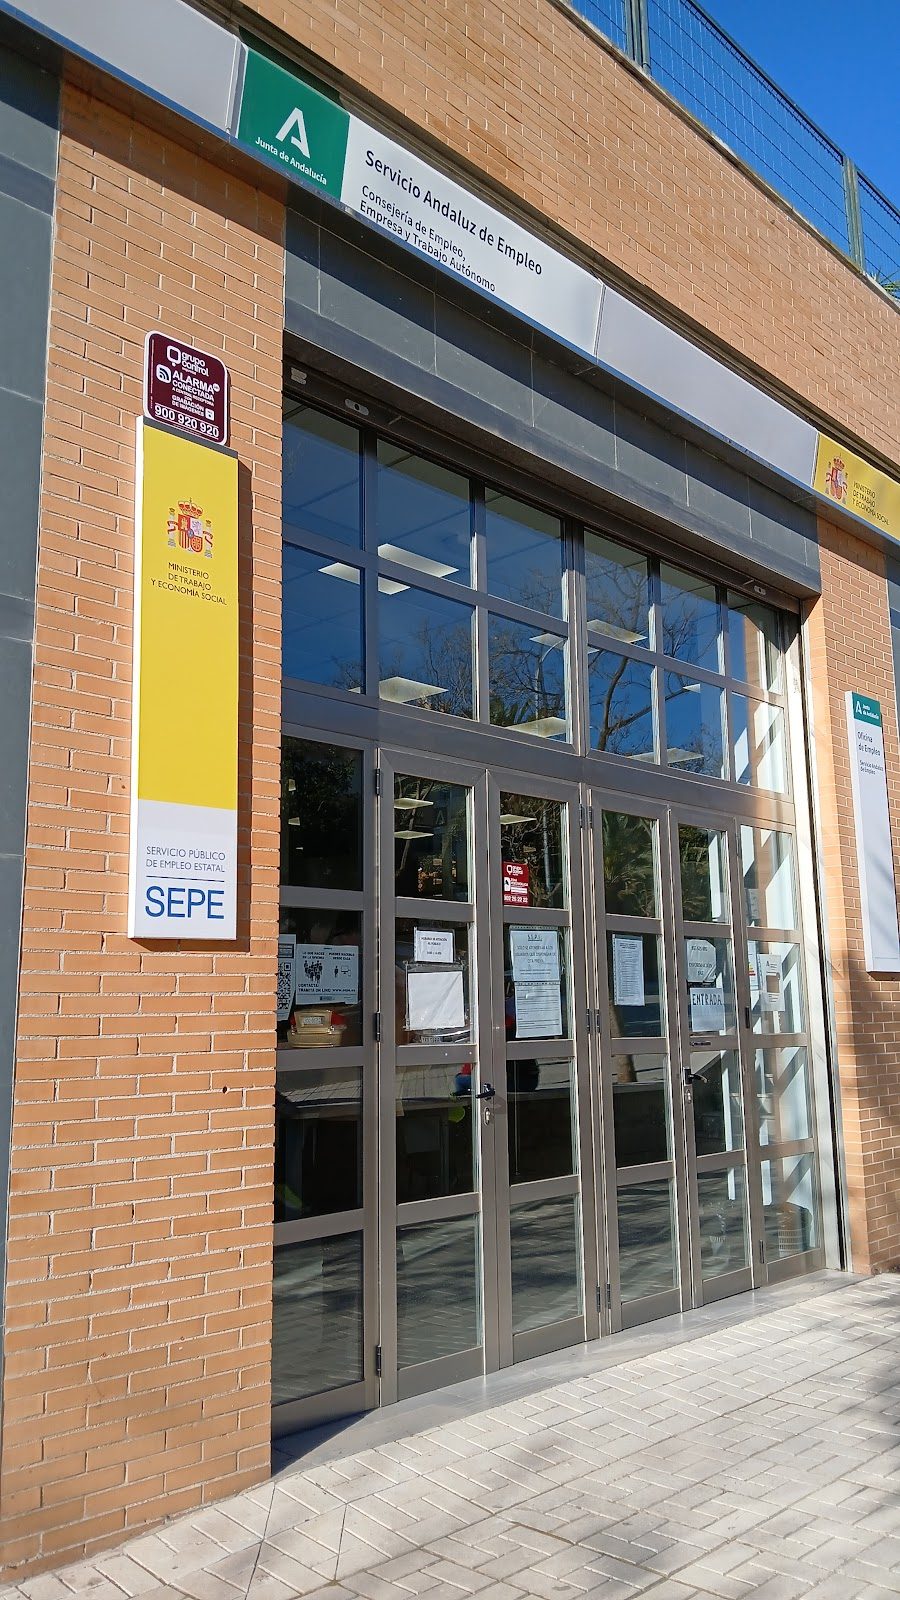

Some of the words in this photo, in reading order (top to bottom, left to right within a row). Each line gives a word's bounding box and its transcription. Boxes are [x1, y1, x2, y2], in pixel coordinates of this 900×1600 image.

[255, 136, 278, 157] Junta
[278, 150, 289, 163] de
[289, 156, 327, 186] Andalucía
[365, 150, 421, 199] Servicio
[423, 191, 476, 235] Andaluz
[478, 226, 494, 247] de
[497, 237, 542, 276] Empleo
[361, 185, 413, 227] Consejería
[415, 219, 427, 234] de
[429, 228, 466, 262] Empleo,
[360, 200, 403, 235] Empresa
[404, 228, 411, 243] y
[412, 232, 448, 267] Trabajo
[449, 257, 496, 293] Autónomo
[181, 351, 206, 367] grupo
[181, 360, 210, 377] control
[171, 380, 214, 403] CONECTADA
[172, 370, 214, 395] ALARMA
[171, 394, 205, 412] GRABACIÓN
[154, 405, 175, 421] 900
[177, 414, 198, 429] 920
[200, 422, 219, 438] 920
[853, 480, 876, 499] MINISTERIO
[168, 562, 209, 580] MINISTERIO
[168, 572, 178, 582] DE
[179, 576, 212, 591] TRABAJO
[150, 578, 156, 586] Y
[157, 580, 200, 598] ECONOMÍA
[201, 592, 227, 606] SOCIAL
[858, 742, 864, 752] de
[864, 744, 881, 756] Empleo
[146, 845, 187, 858] SERVICIO
[188, 848, 226, 861] PÚBLICO
[145, 859, 158, 868] DE
[159, 859, 192, 870] EMPLEO
[194, 862, 225, 873] ESTATAL
[145, 885, 225, 920] SEPE
[692, 993, 723, 1006] ENTRADA
